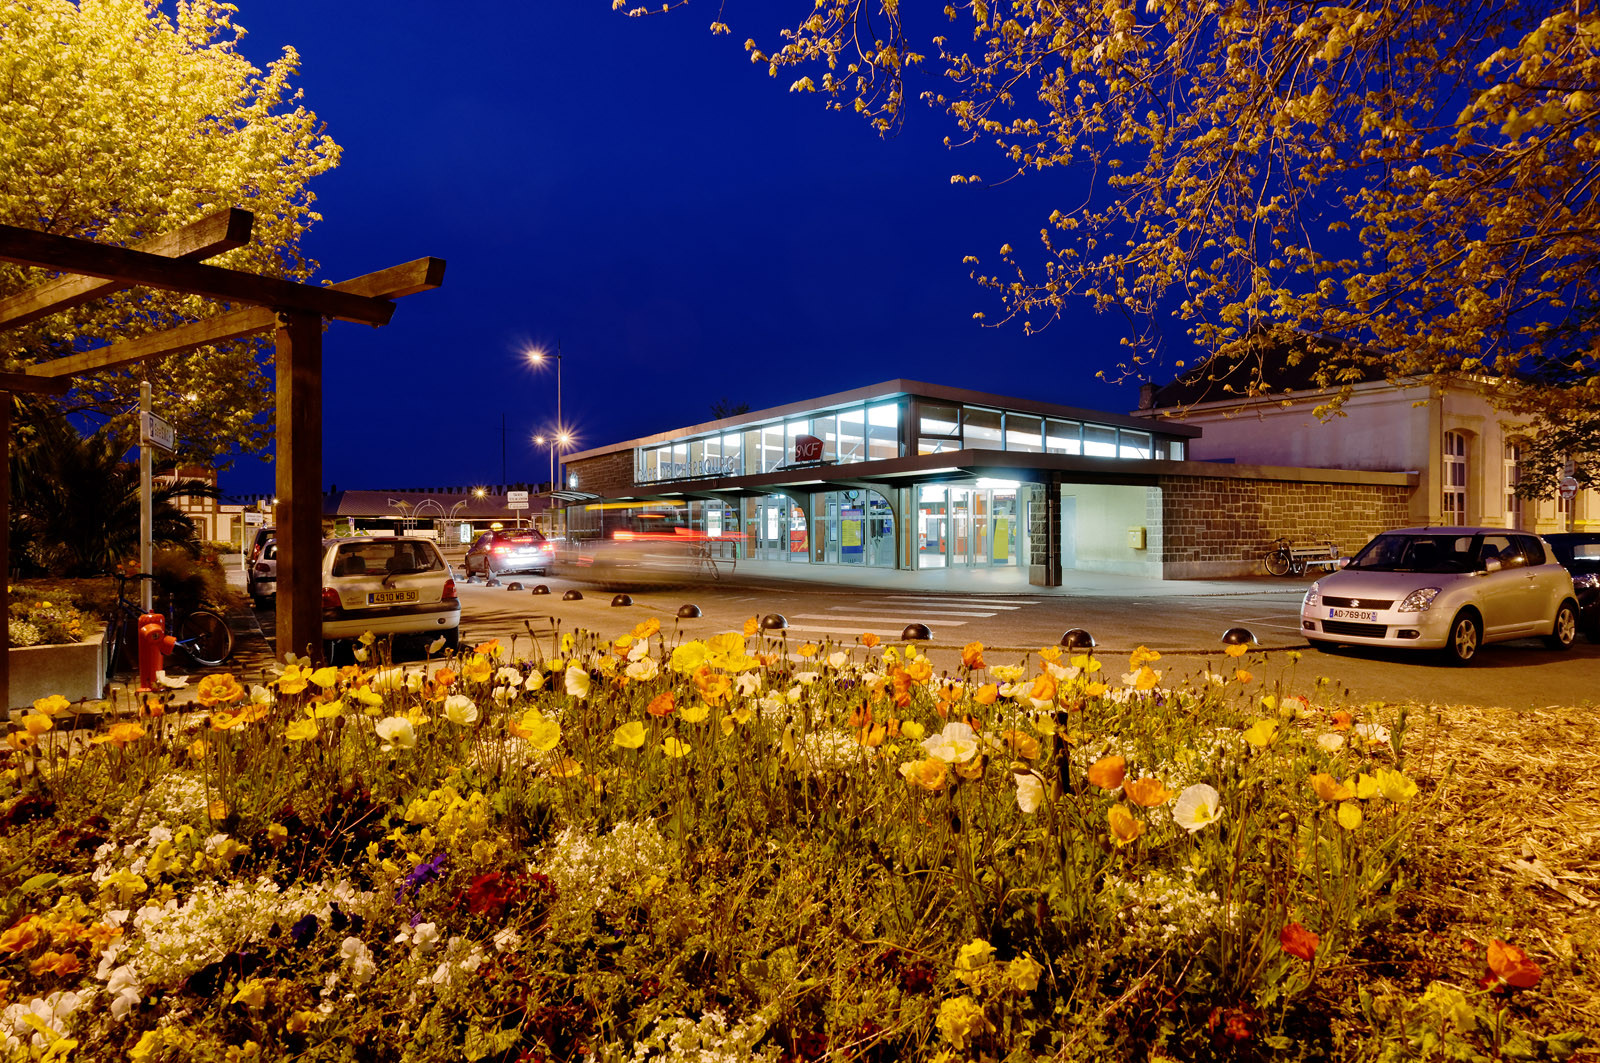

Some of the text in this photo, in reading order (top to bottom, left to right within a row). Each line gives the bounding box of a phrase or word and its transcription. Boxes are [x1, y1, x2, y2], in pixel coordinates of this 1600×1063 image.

[795, 442, 820, 458] SNCF
[638, 466, 657, 481] GARE
[675, 456, 734, 478] CHERBOURG
[376, 594, 394, 602] 4910
[406, 591, 416, 600] 50
[1334, 610, 1371, 619] AD-769-DX
